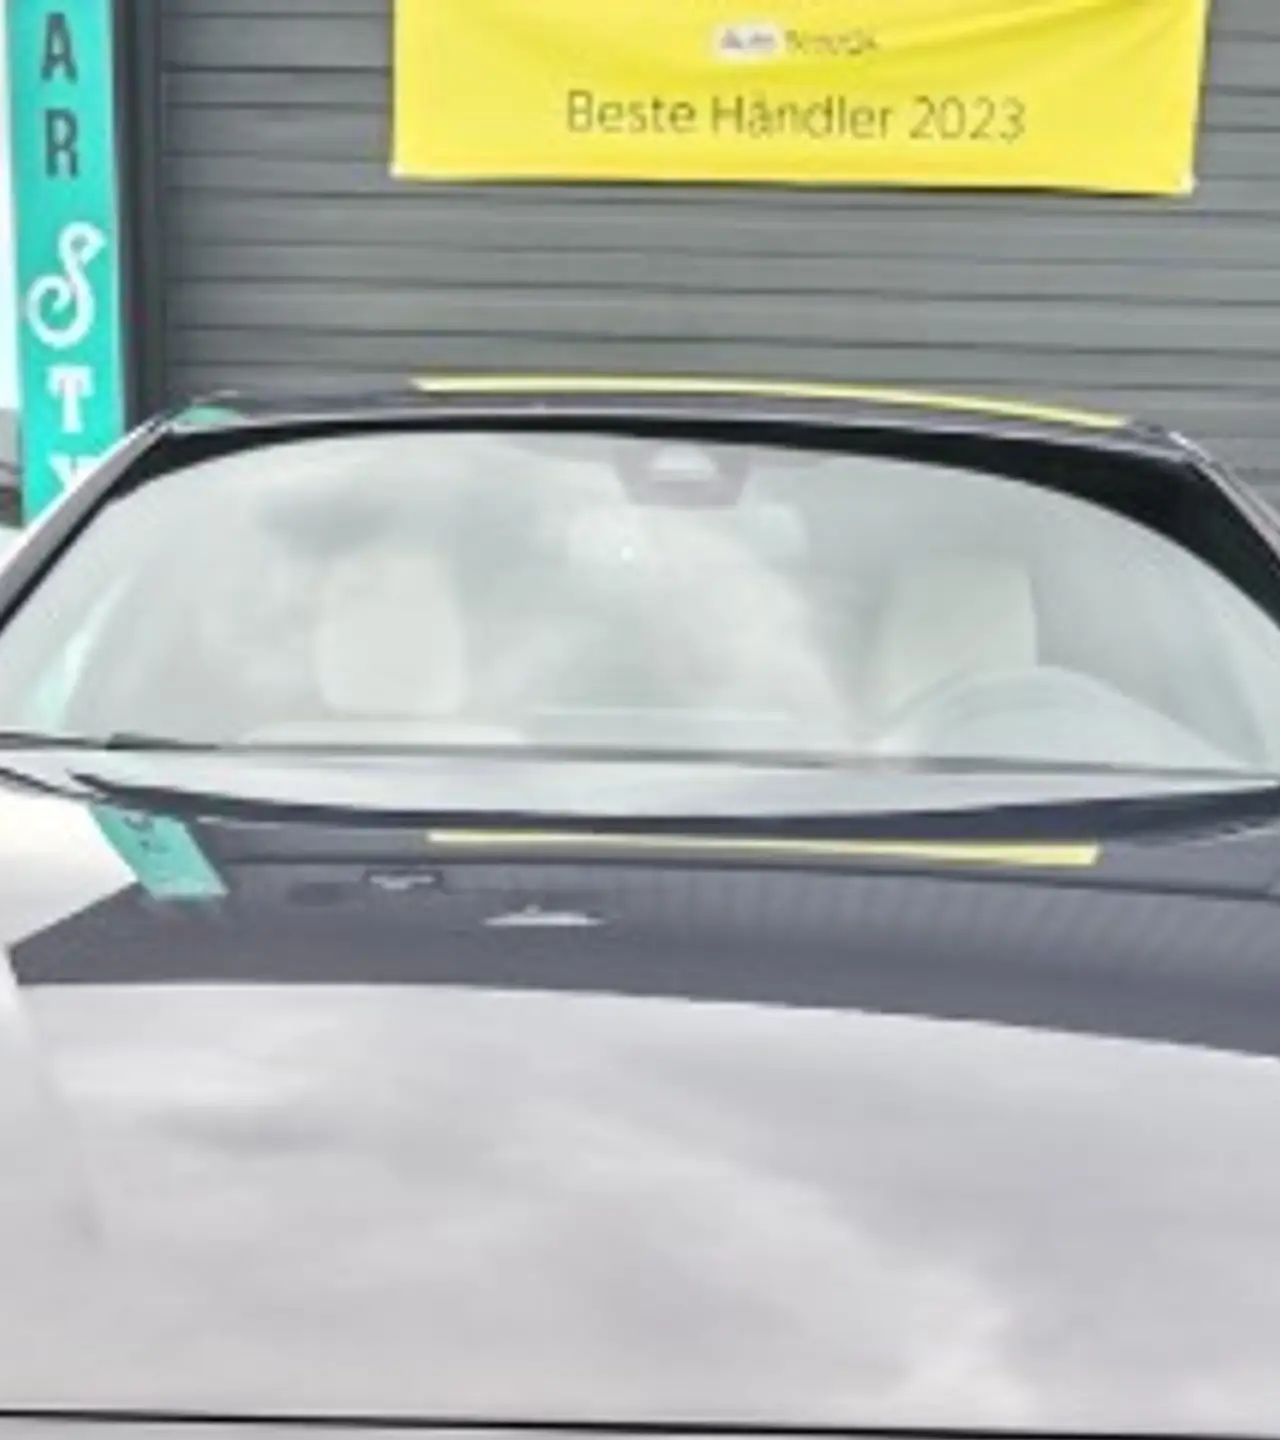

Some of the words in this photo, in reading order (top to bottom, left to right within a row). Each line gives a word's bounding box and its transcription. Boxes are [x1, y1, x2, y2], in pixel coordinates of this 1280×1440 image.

[566, 89, 697, 134] Beste
[711, 95, 892, 138] Händler
[908, 95, 1027, 143] 2023
